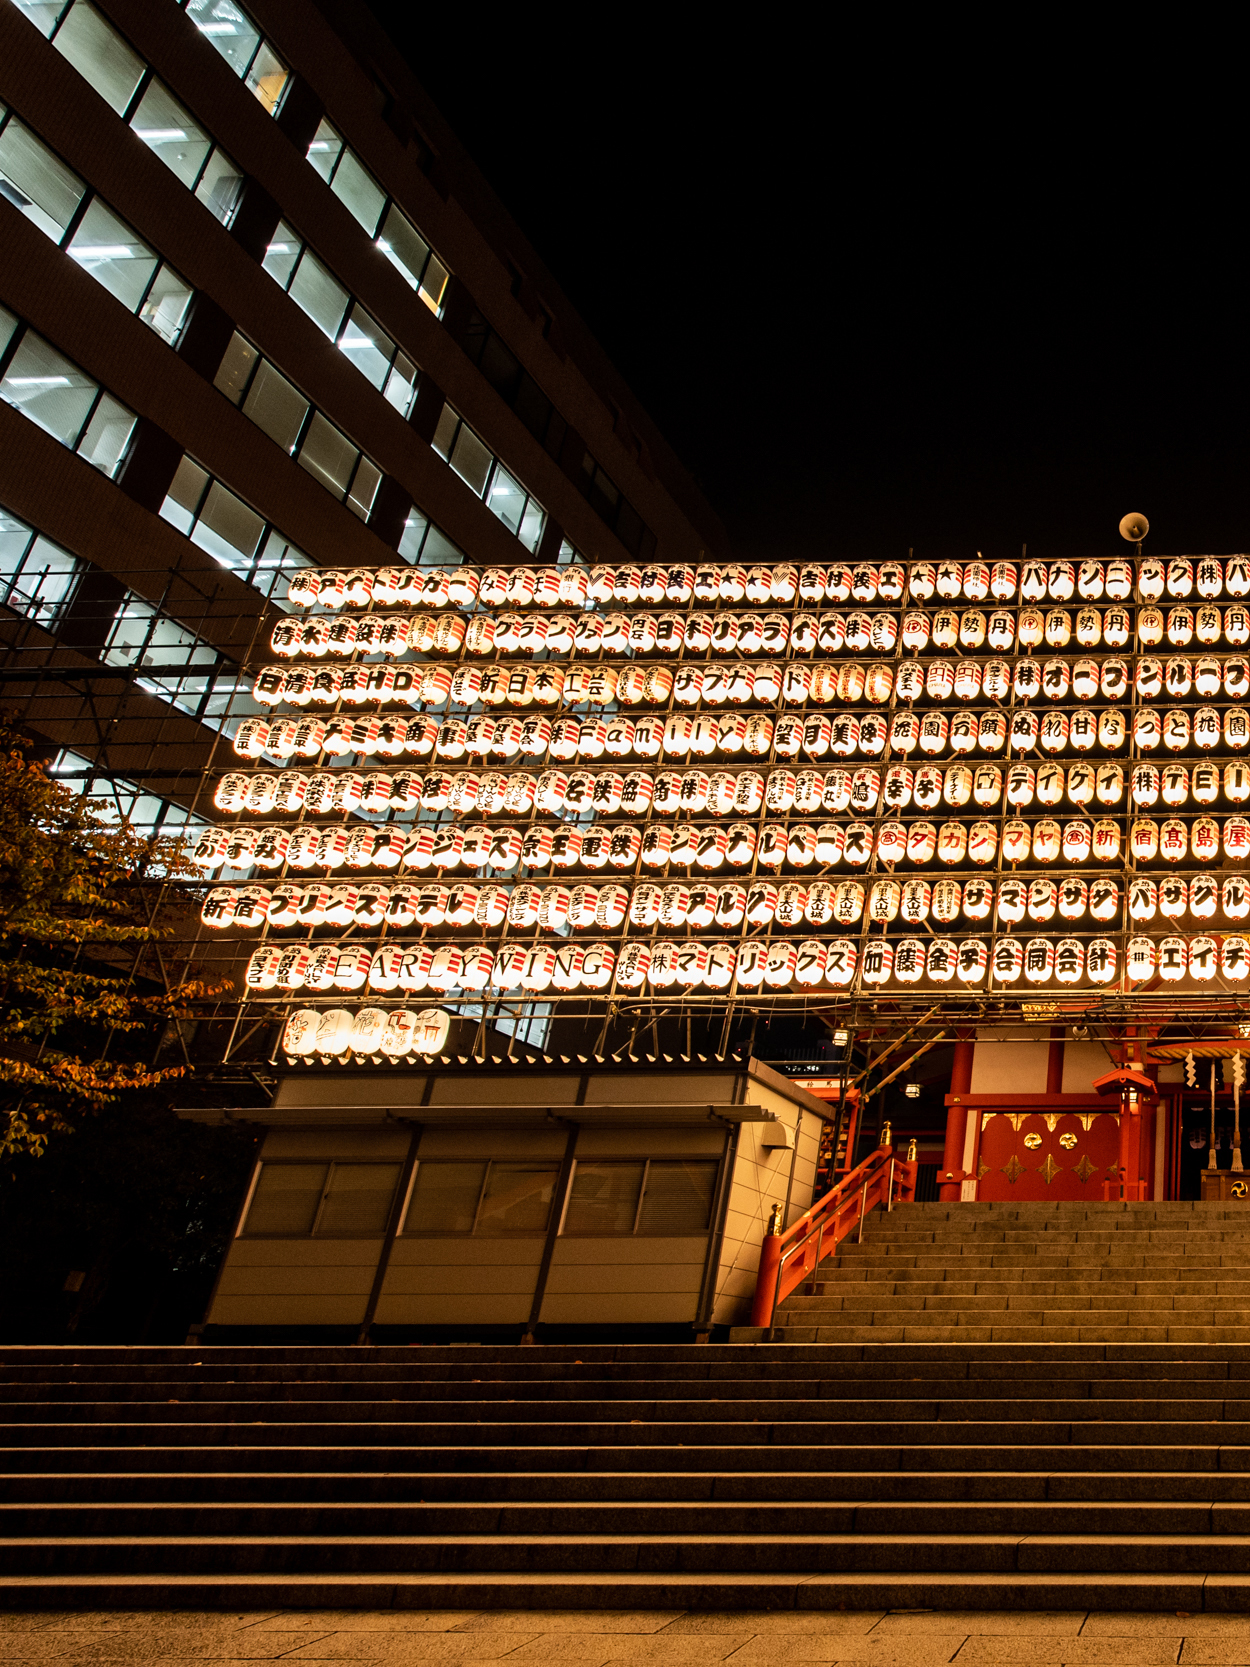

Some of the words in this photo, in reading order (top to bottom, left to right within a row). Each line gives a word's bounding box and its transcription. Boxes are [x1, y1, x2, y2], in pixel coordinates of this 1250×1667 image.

[934, 616, 1008, 636] 伊勢丹
[1047, 614, 1126, 633] 伊勢丹
[1171, 611, 1246, 632] 伊勢丹
[676, 669, 801, 692] サブナード
[908, 829, 1056, 852] タカシマヤ
[202, 892, 466, 921] 新宿プリンスホテル
